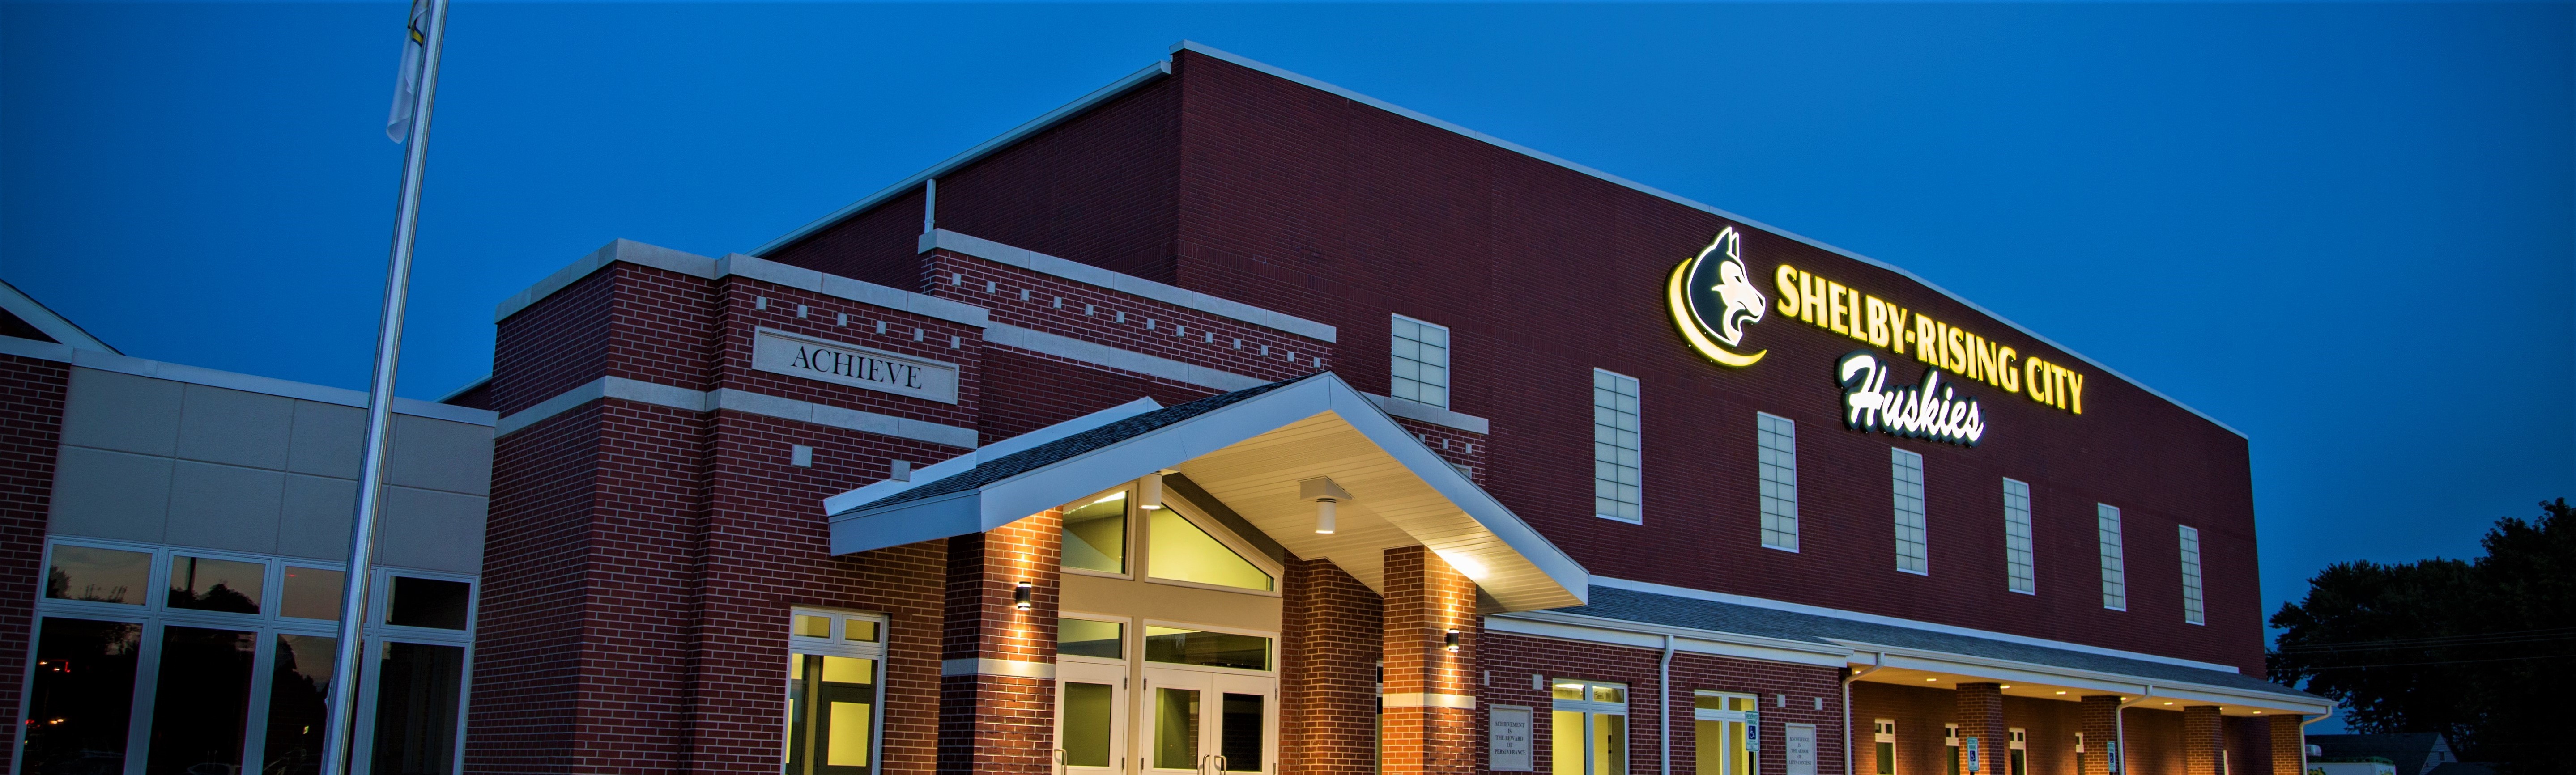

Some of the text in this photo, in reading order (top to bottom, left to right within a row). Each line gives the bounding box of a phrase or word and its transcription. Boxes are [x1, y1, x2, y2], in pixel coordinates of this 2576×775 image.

[791, 346, 922, 390] ACHIEVE
[1777, 264, 2083, 415] SHELBY-RISING CITY
[1842, 354, 1985, 443] Huskies
